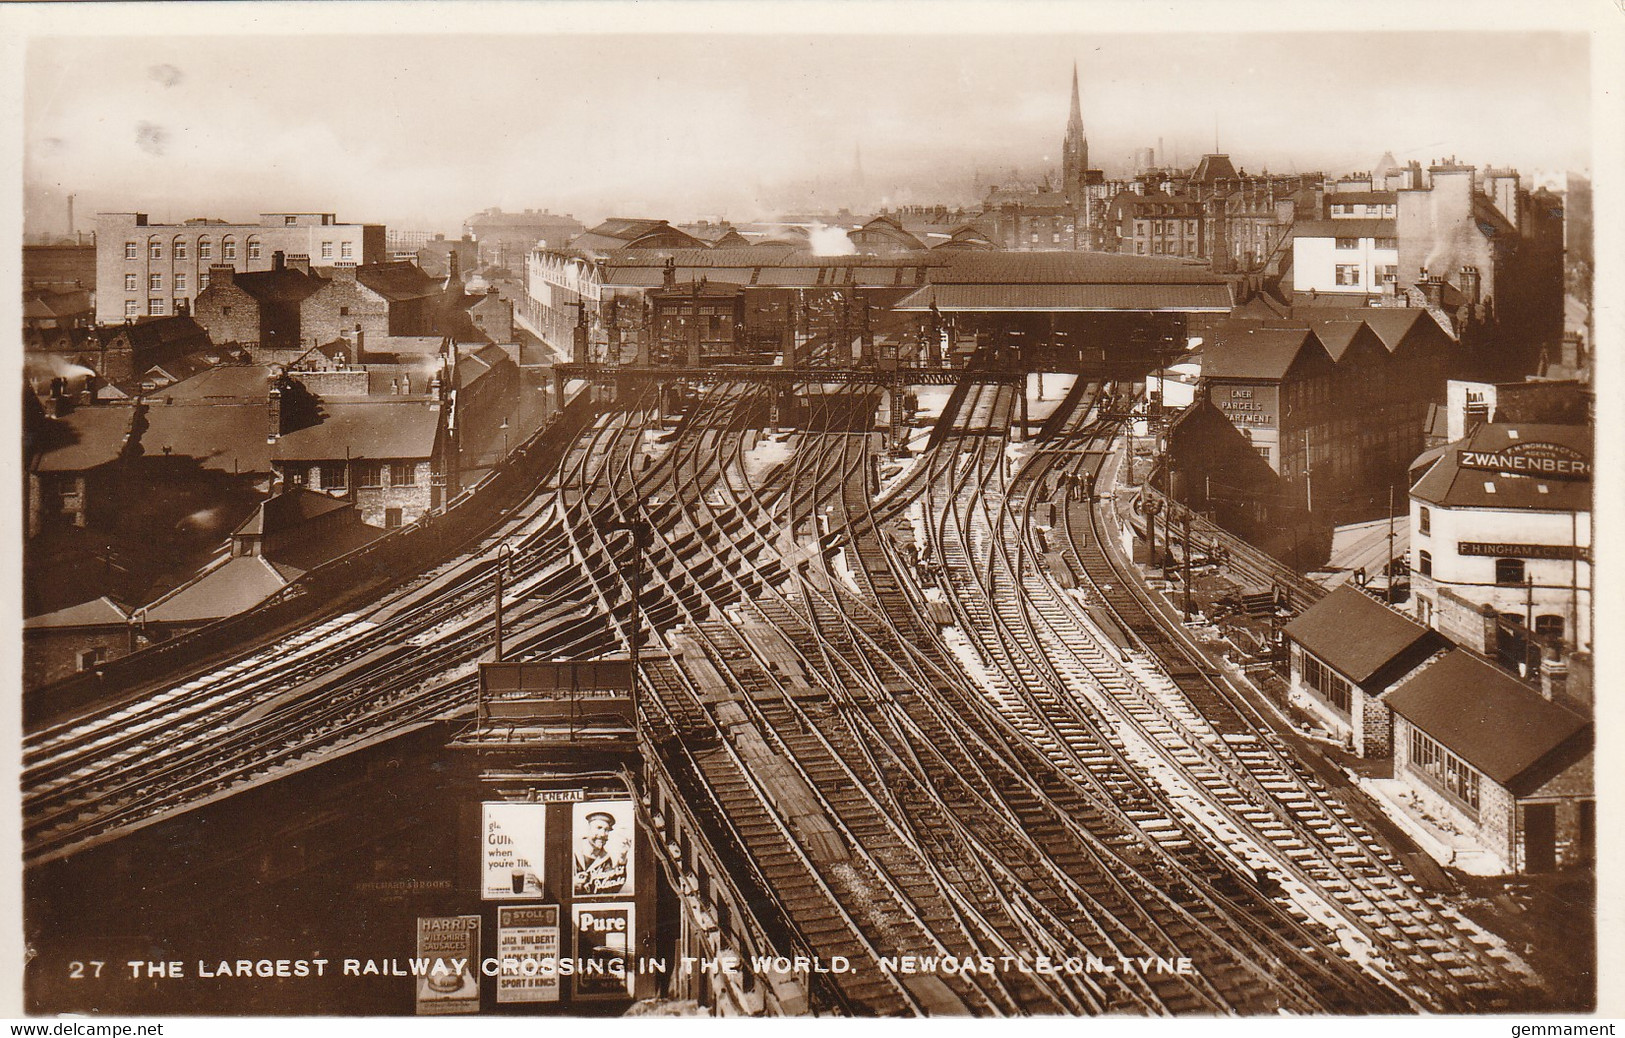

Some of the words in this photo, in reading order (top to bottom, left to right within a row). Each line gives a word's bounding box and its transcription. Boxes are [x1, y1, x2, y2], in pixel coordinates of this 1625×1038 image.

[1231, 390, 1252, 398] LNER
[1222, 401, 1262, 410] PARCELS
[1224, 413, 1271, 423] PARTMENT
[1462, 452, 1590, 474] ZWANENBER
[1484, 545, 1532, 555] INGHAM
[488, 848, 513, 856] when
[488, 858, 514, 871] you're
[414, 880, 452, 888] BROOKS
[513, 910, 544, 918] STOLL
[422, 919, 477, 930] HARRIS
[580, 913, 626, 932] Pure
[424, 933, 467, 942] WILTSHIRE
[502, 936, 517, 945] JACK
[521, 935, 556, 944] HULBERT
[424, 942, 466, 952] SAUSAGES
[502, 979, 526, 988] SPORT
[535, 978, 556, 987] KINGS
